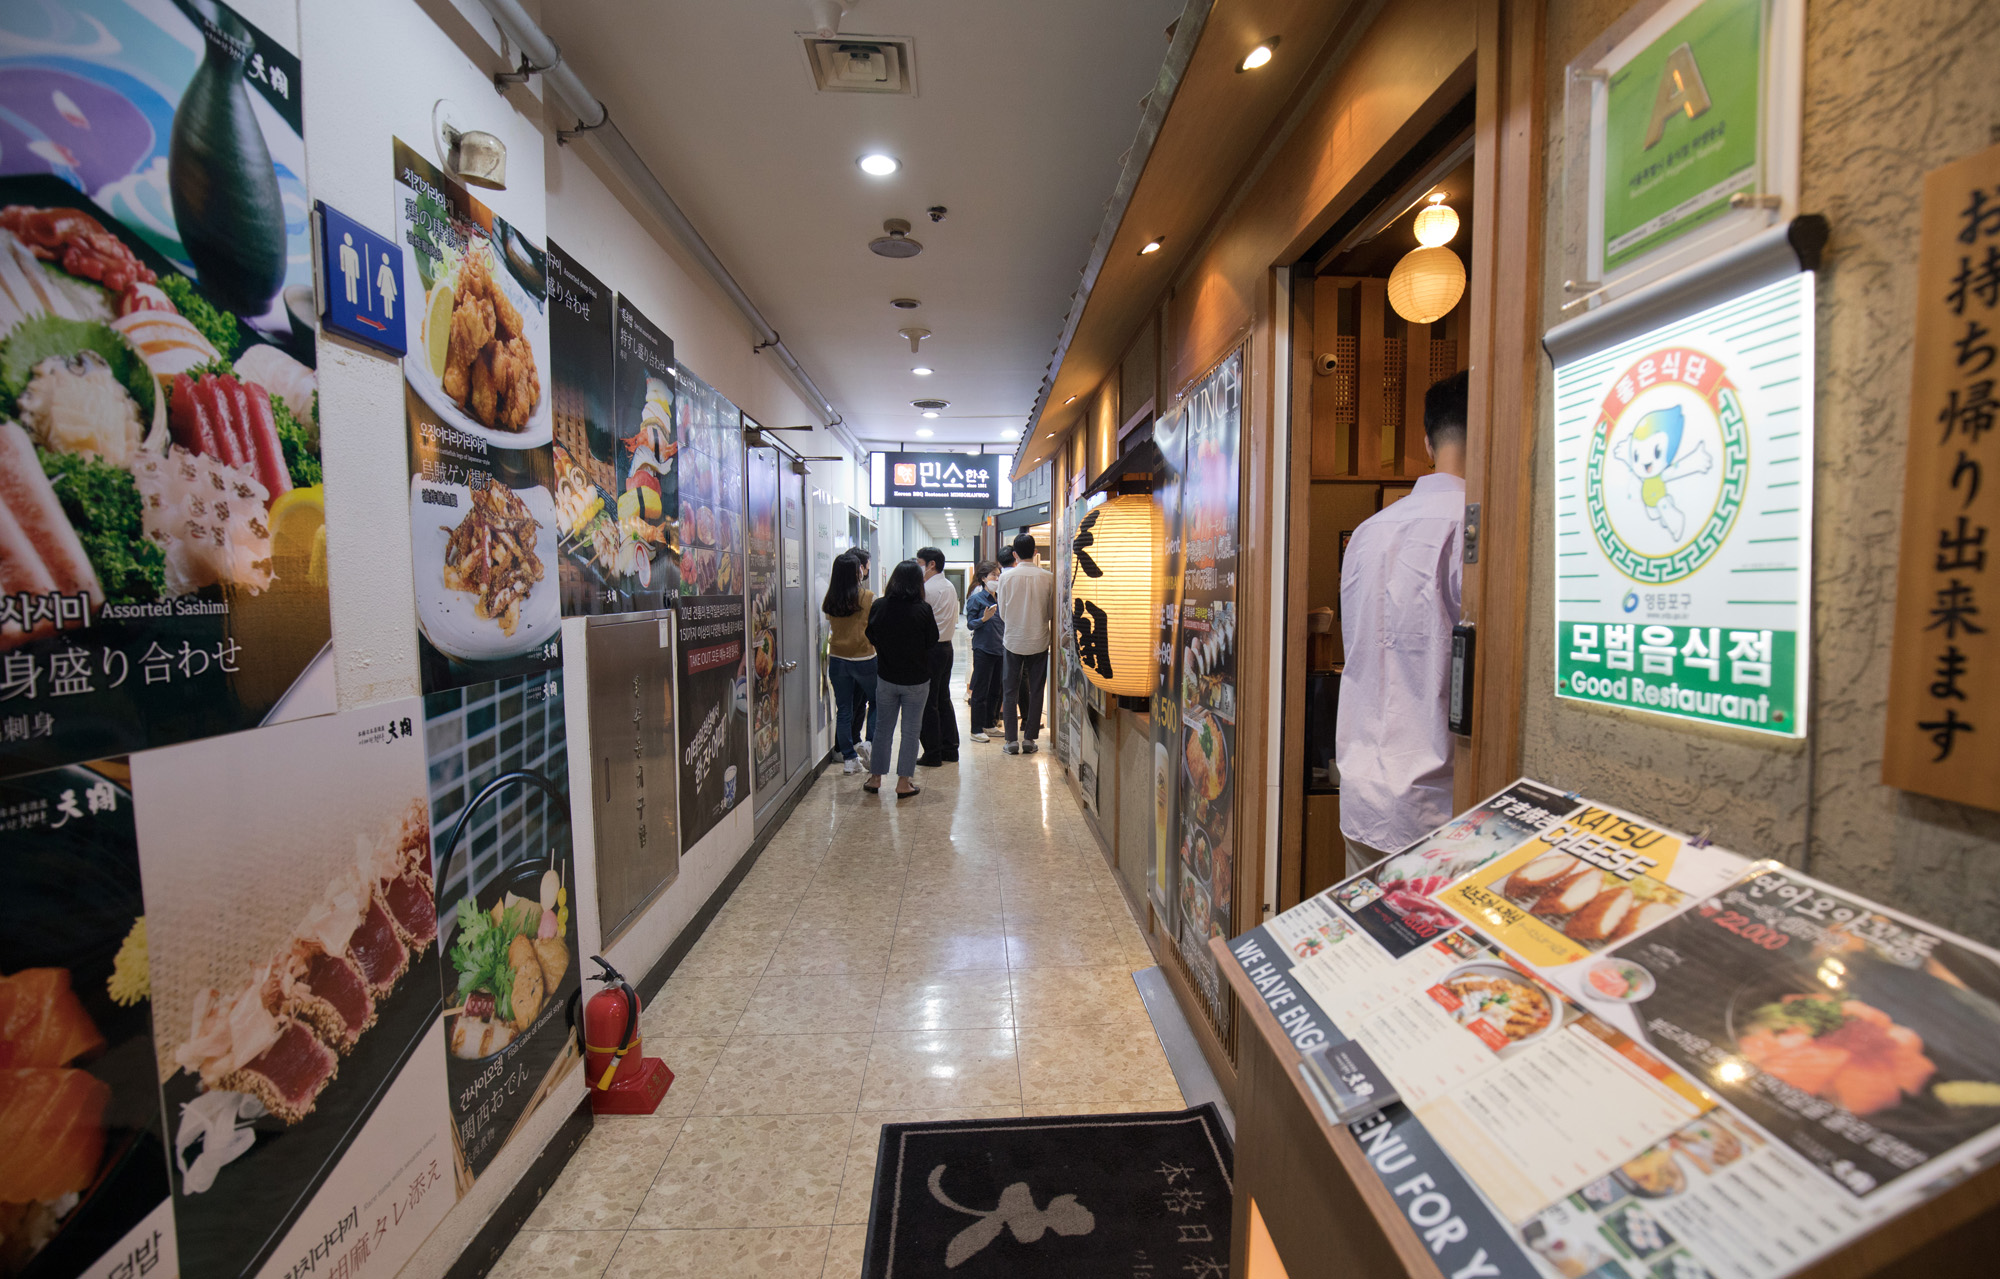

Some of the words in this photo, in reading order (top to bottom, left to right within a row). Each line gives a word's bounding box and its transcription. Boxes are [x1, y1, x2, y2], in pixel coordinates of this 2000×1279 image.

[1644, 42, 1711, 151] A
[1187, 361, 1239, 438] LUNCH
[1615, 351, 1707, 405] 좋은식단
[420, 422, 488, 456] 오징어다리가라아게
[920, 461, 964, 488] 민소
[964, 468, 990, 484] 한우
[1917, 186, 2000, 764] お持ち帰り出来ます
[1165, 535, 1181, 556] Event
[0, 593, 91, 631] 사시미
[102, 602, 172, 618] Assorted
[176, 600, 229, 615] Sashimi
[681, 606, 692, 620] 20년
[692, 605, 706, 620] 전통의
[1644, 593, 1692, 611] 영등포구
[679, 625, 697, 641] 150가지
[697, 623, 711, 639] 이상의
[1570, 622, 1773, 688] 모범음식점
[0, 637, 242, 700] 身盛り合わせ
[689, 653, 701, 668] TAKE
[701, 650, 711, 665] OUT
[711, 649, 719, 663] 모든
[1570, 670, 1629, 703] Good
[1631, 676, 1770, 724] Restaurant
[1490, 794, 1563, 831] すき焼き
[1569, 806, 1667, 849] KATSU
[1540, 822, 1659, 882] CHEESE
[1234, 938, 1266, 968] WE
[1249, 961, 1297, 1010] HAVE
[507, 1045, 520, 1060] Fish
[519, 1034, 532, 1048] cake
[537, 1010, 553, 1031] Kansai
[459, 1054, 504, 1112] 간사이오뎅
[1395, 1172, 1469, 1255] FOR
